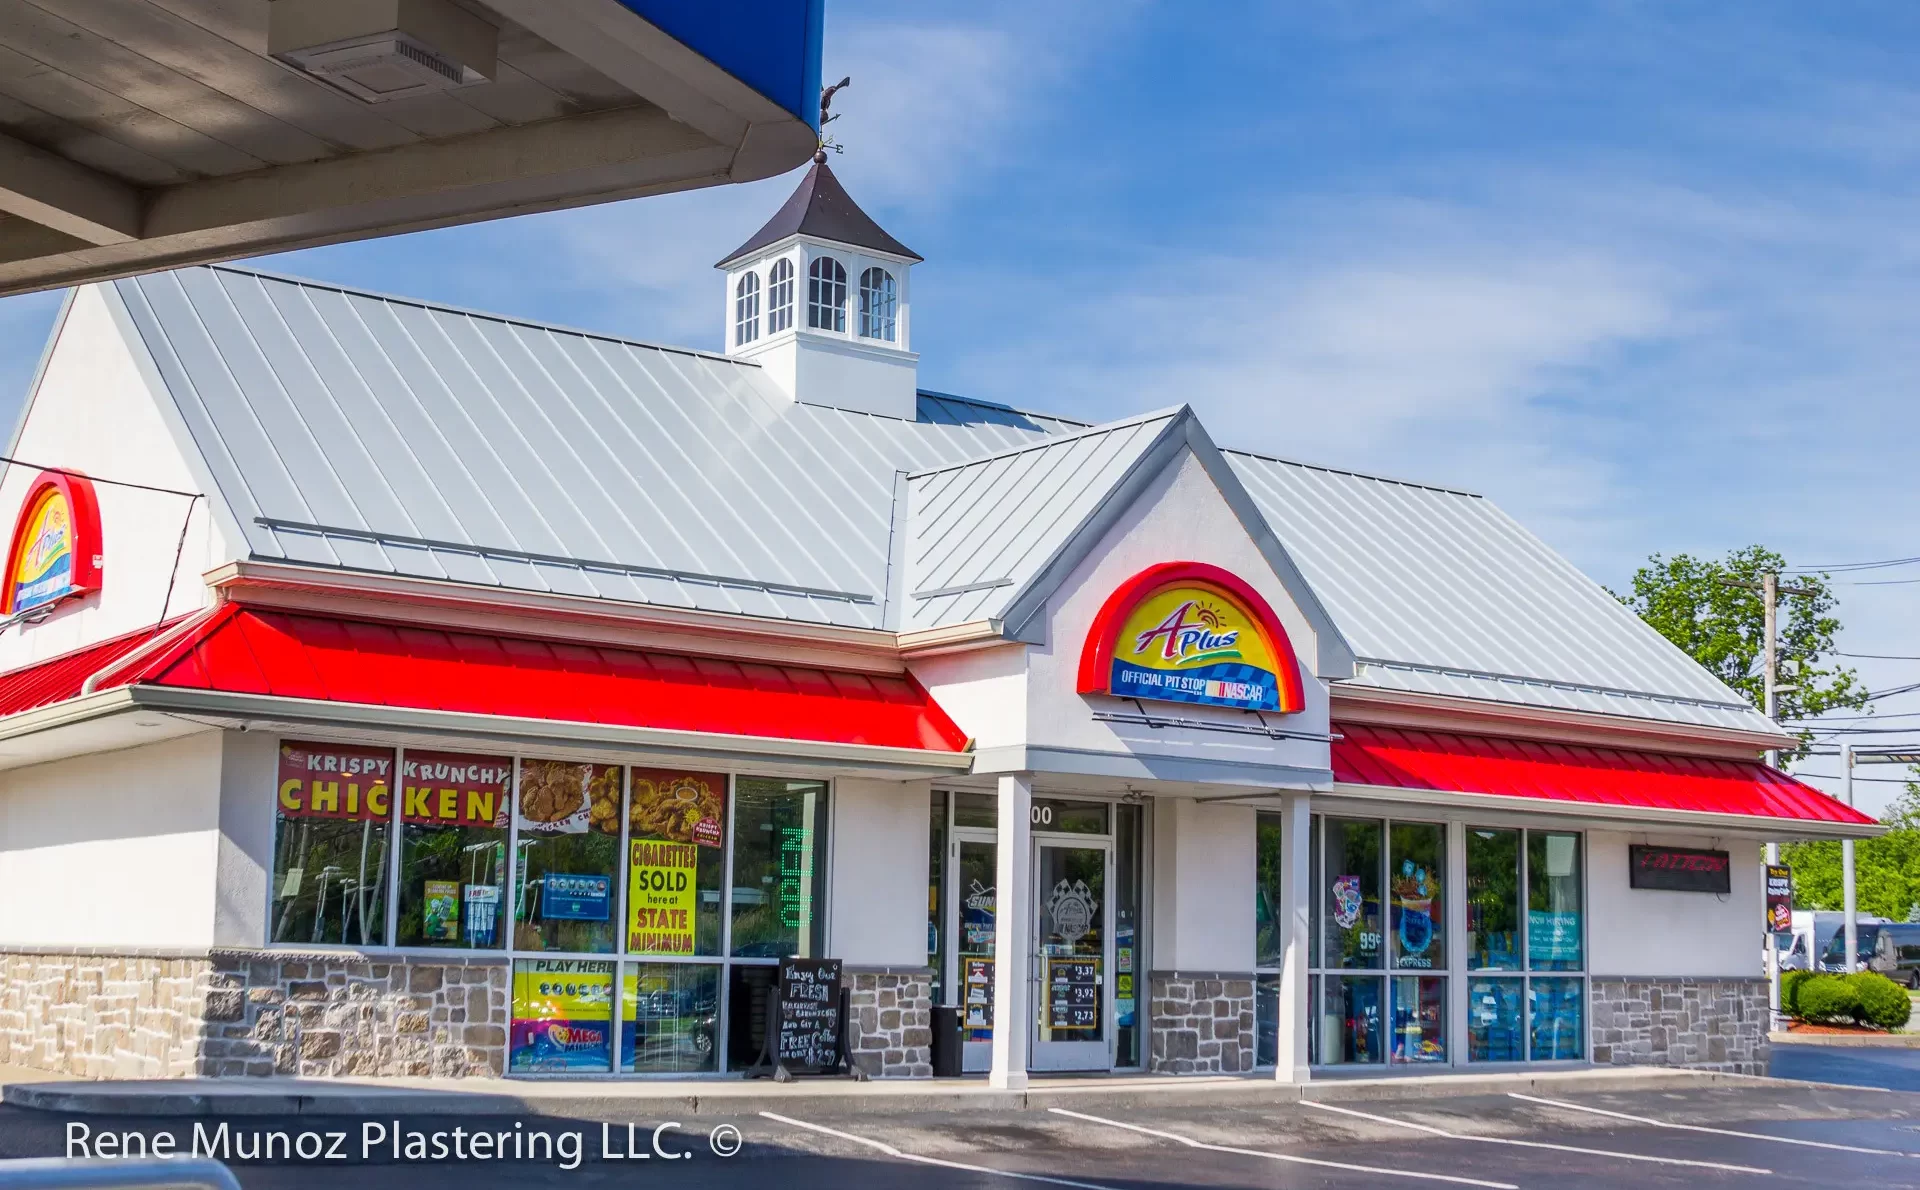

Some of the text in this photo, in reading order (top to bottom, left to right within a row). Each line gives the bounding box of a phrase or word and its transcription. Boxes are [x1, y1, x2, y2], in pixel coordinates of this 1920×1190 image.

[1121, 669, 1264, 702] OFFICIAL PIT STOP NASCAR
[307, 754, 390, 776] KRISPY
[403, 760, 510, 784] KRUNCHY
[632, 843, 696, 869] CIGARETTES
[639, 870, 687, 892] SOLD
[780, 828, 814, 928] OPEN
[647, 893, 668, 905] here
[637, 907, 688, 930] STATE
[630, 932, 693, 953] MINIMUM
[536, 960, 574, 973] PLAY
[567, 1028, 602, 1044] MEGA
